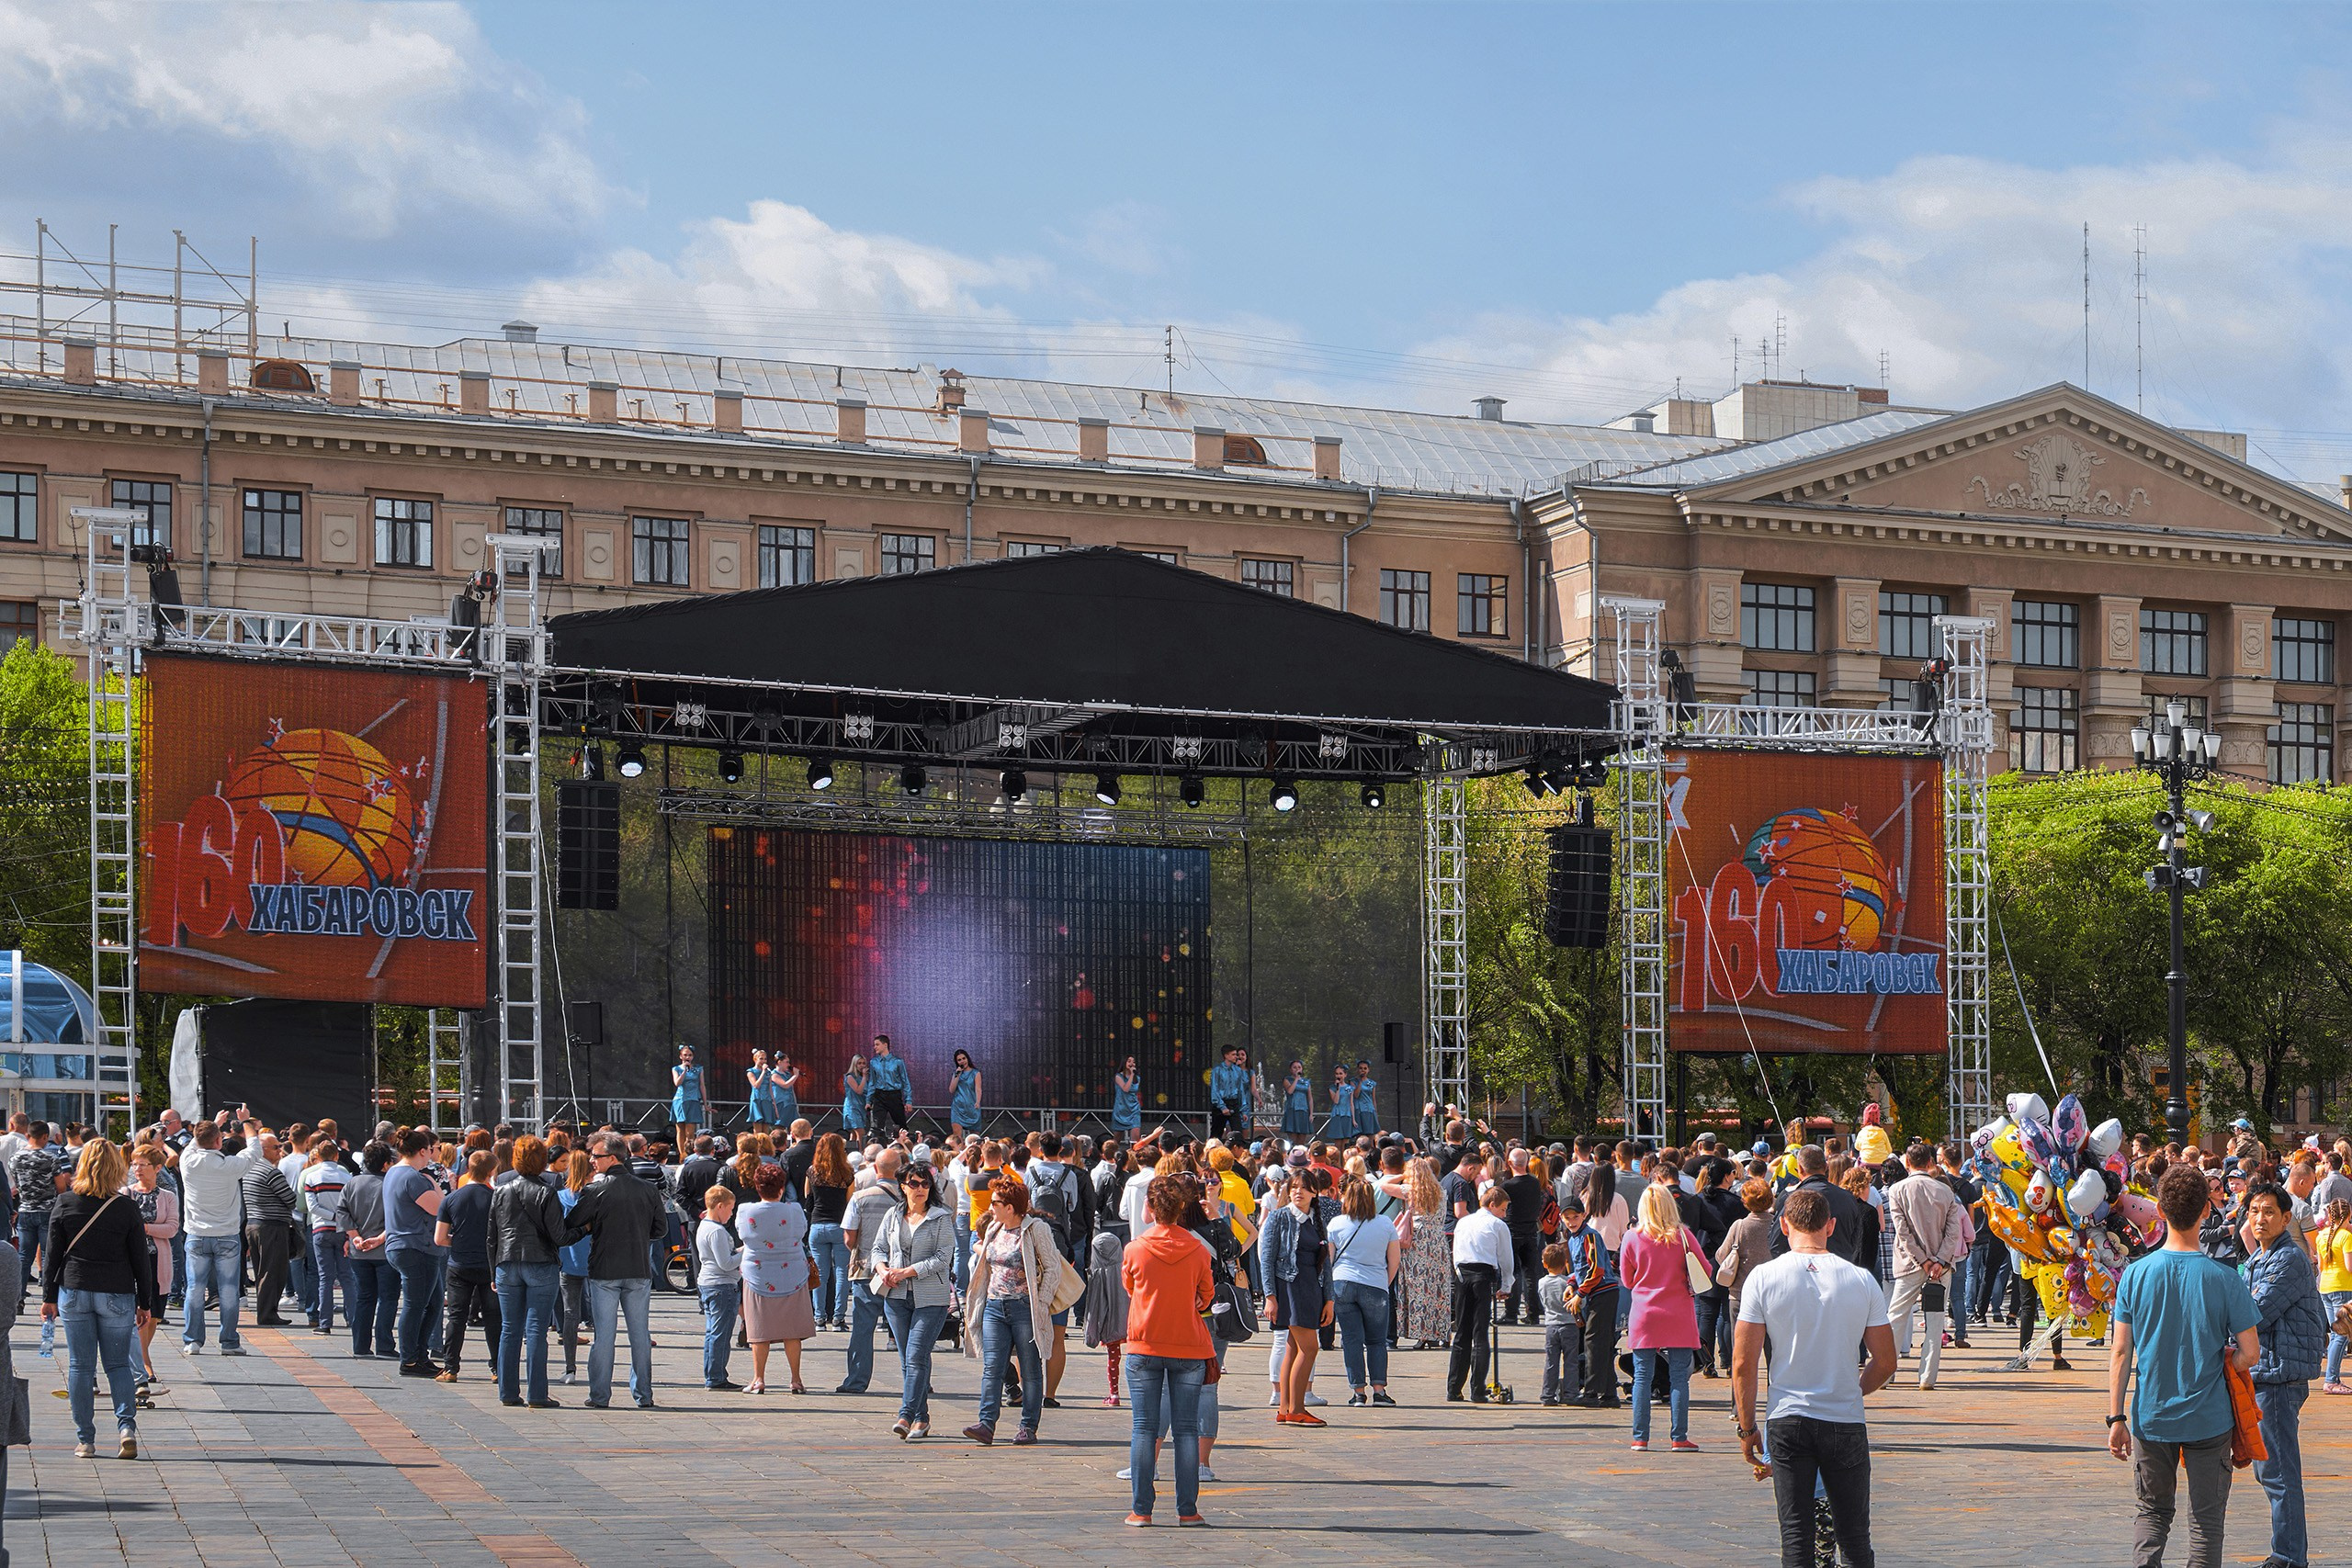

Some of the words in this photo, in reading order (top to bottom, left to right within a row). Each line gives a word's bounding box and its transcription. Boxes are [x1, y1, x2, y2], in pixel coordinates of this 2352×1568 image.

[485, 574, 492, 587] 1
[148, 794, 286, 948] 160
[246, 883, 479, 942] ХАБАРОВСК
[1674, 861, 1802, 1012] 160
[1775, 948, 1944, 995] ХАБАРОВСК
